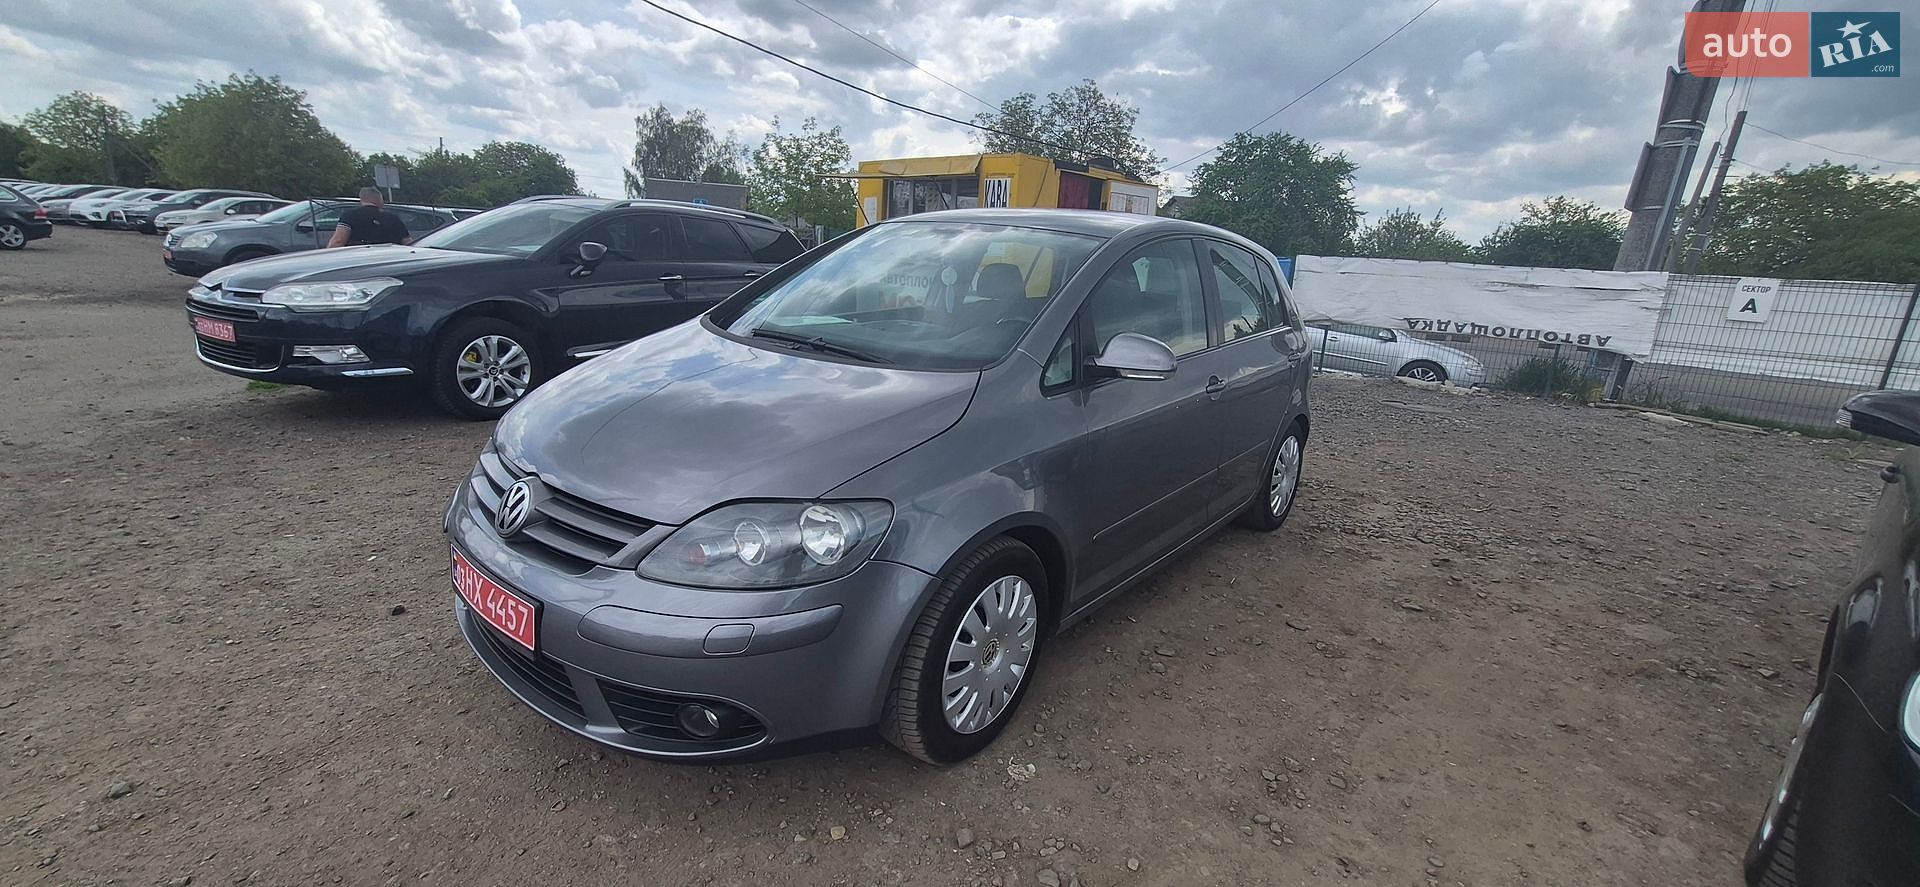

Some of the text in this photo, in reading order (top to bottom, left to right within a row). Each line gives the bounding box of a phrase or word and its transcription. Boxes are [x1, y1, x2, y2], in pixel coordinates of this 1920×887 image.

[1741, 285, 1771, 293] СЕКТОР
[1406, 318, 1613, 347] АВТОПЛОЩАДКА
[486, 588, 529, 636] 4457
